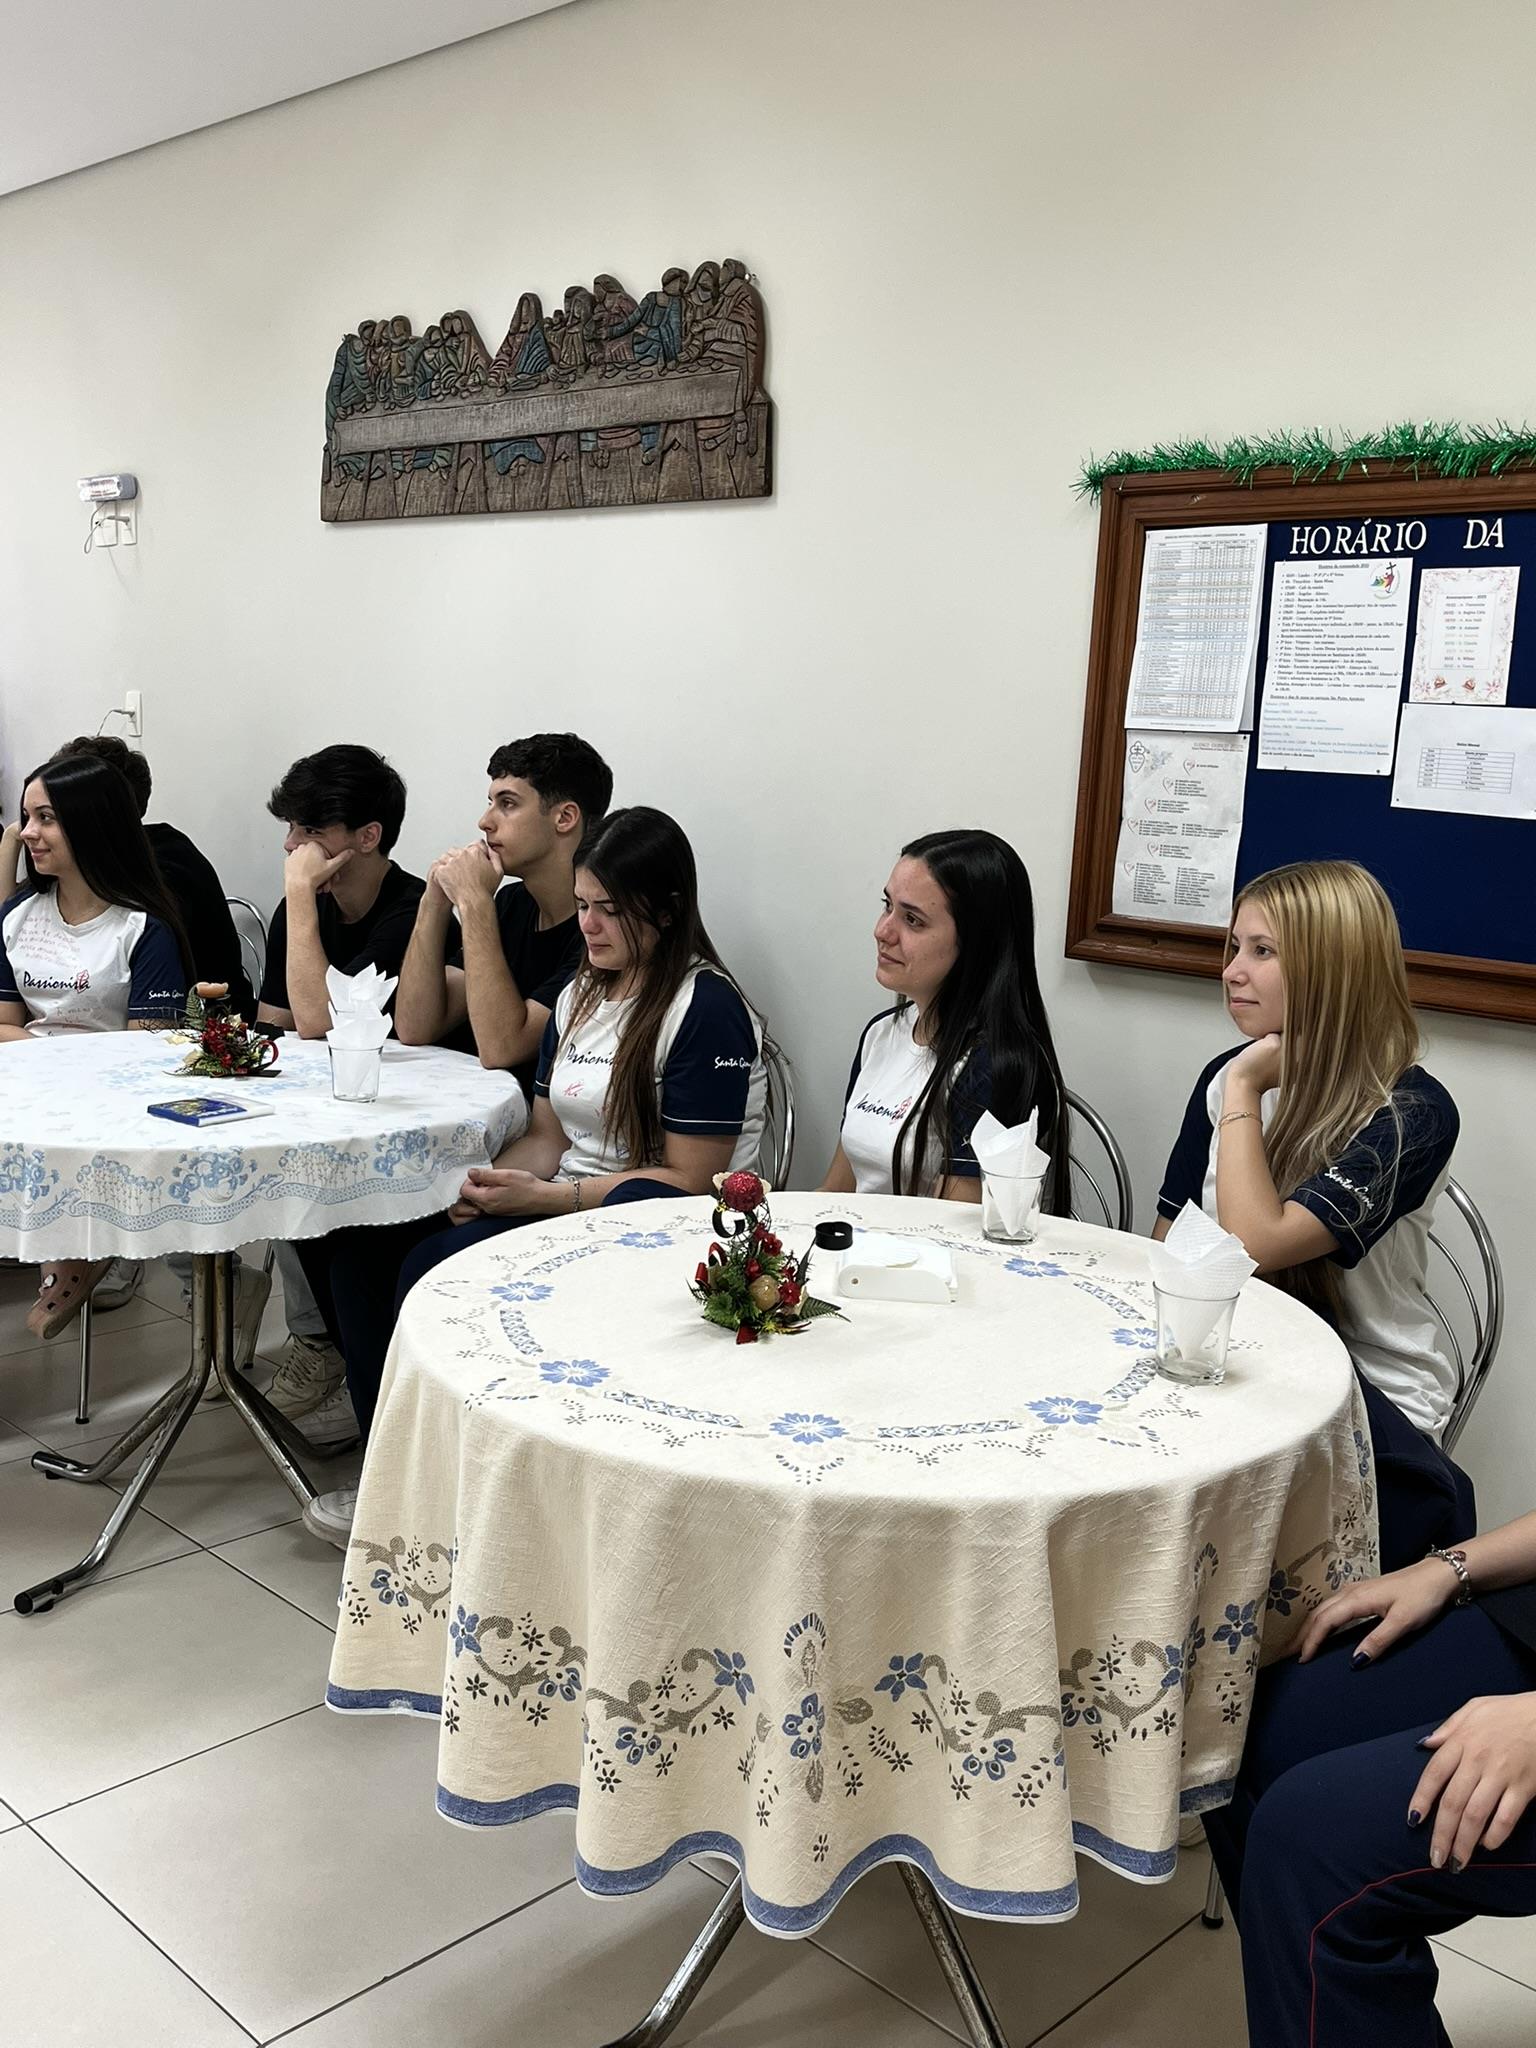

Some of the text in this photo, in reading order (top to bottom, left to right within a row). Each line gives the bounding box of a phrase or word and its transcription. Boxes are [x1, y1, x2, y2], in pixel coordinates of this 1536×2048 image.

[1289, 517, 1504, 555] HORÁRIO DA
[23, 969, 91, 994] Passionista
[148, 989, 171, 1000] Santa
[714, 1055, 739, 1070] Santa
[1323, 1165, 1354, 1190] Santa
